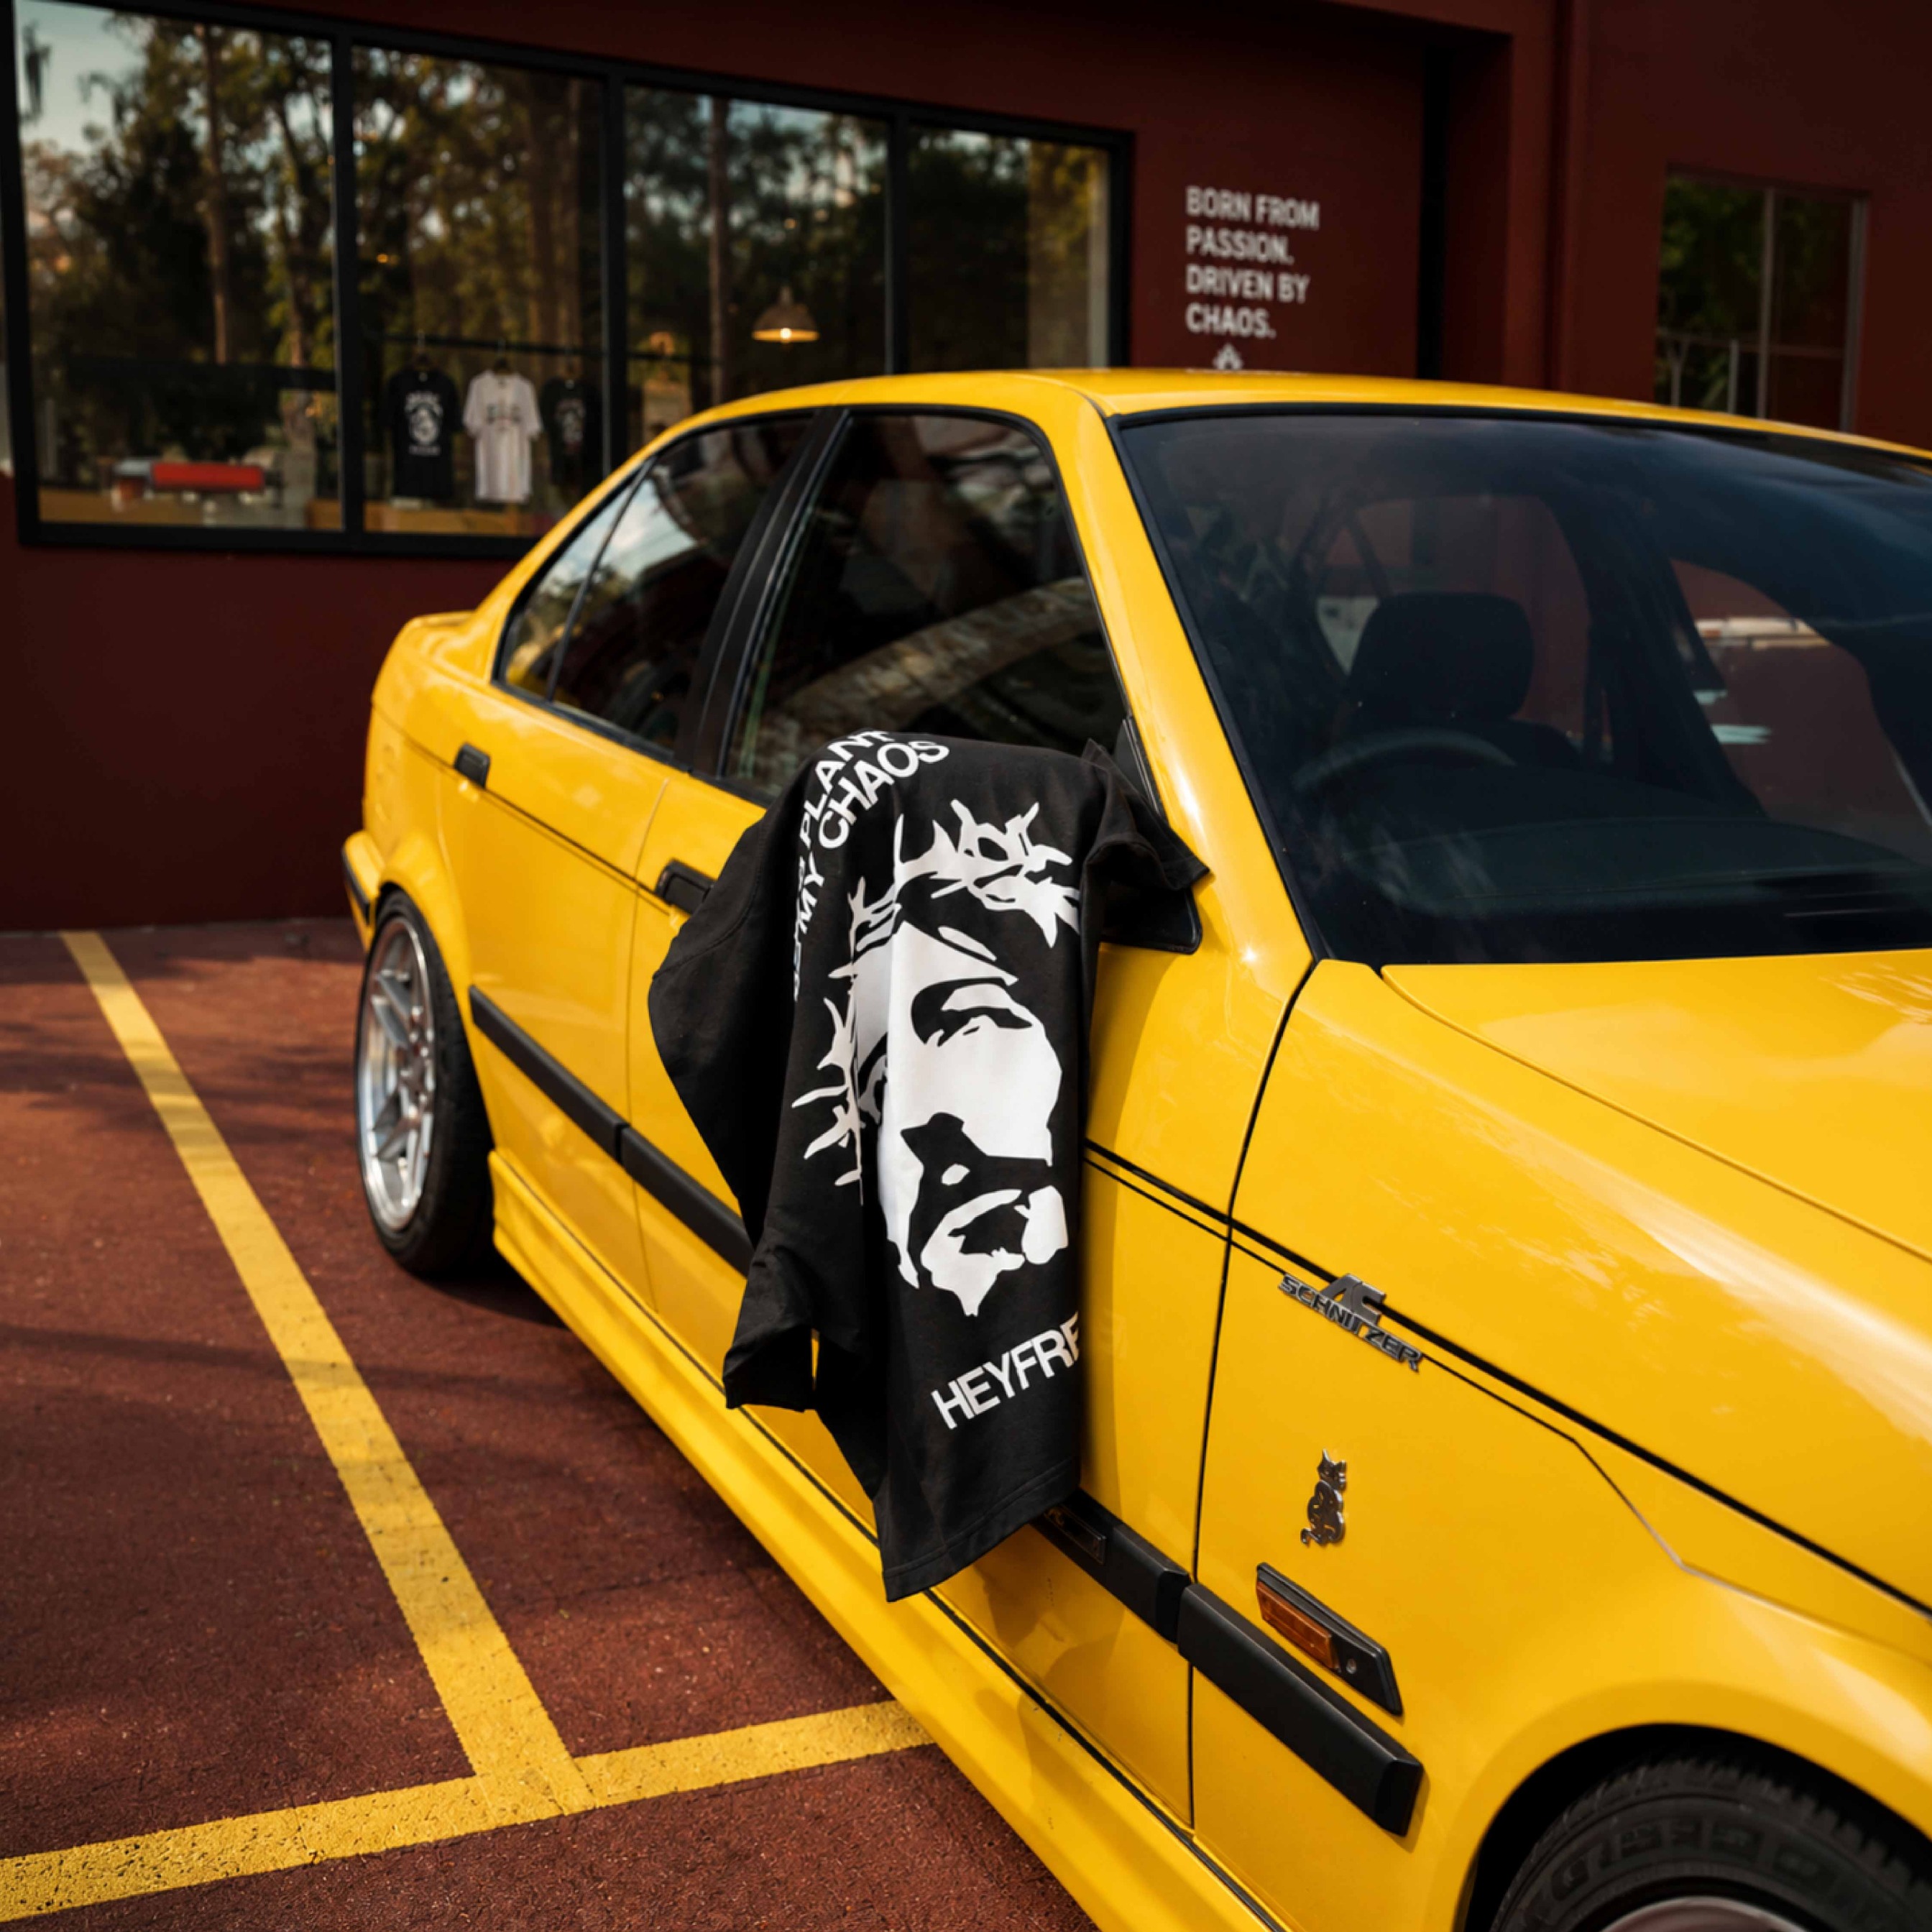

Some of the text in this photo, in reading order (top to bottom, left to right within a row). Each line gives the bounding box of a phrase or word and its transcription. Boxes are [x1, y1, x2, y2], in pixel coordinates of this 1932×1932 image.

[1186, 185, 1320, 231] BORN FROM
[1186, 224, 1294, 264] PASSION.
[1186, 264, 1310, 303] DRIVEN BY
[1186, 302, 1276, 339] CHAOS.
[818, 740, 950, 849] CHAOS
[1277, 1272, 1425, 1375] SCHNITZER
